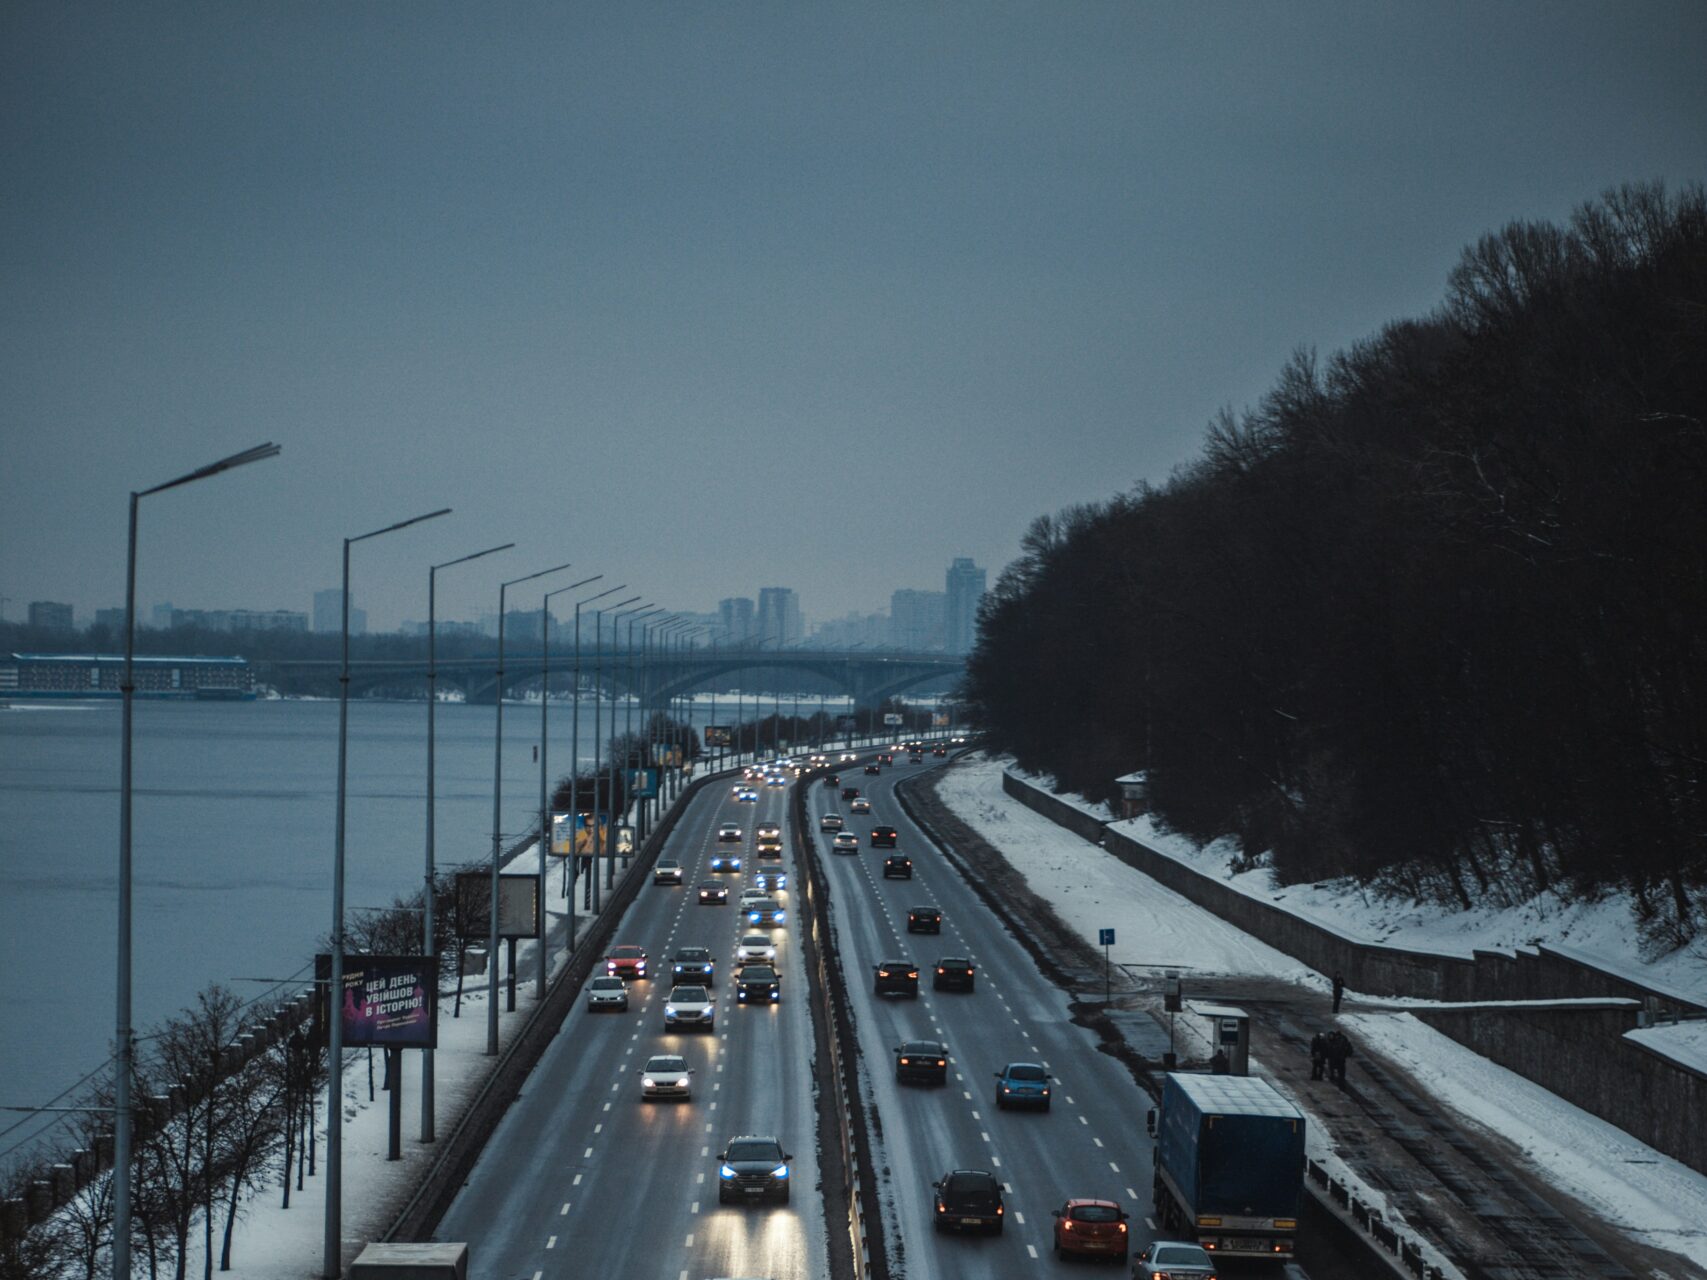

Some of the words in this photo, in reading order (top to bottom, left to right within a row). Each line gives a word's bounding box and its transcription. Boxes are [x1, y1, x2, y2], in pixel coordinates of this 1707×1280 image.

[345, 979, 364, 988] РОКУ
[366, 977, 386, 993] ЦЕЙ
[389, 974, 417, 989] ДЕНЬ
[366, 986, 413, 1005] УВІЙШОВ
[365, 1007, 373, 1017] В
[376, 996, 423, 1015] ІСТОРІЮ!
